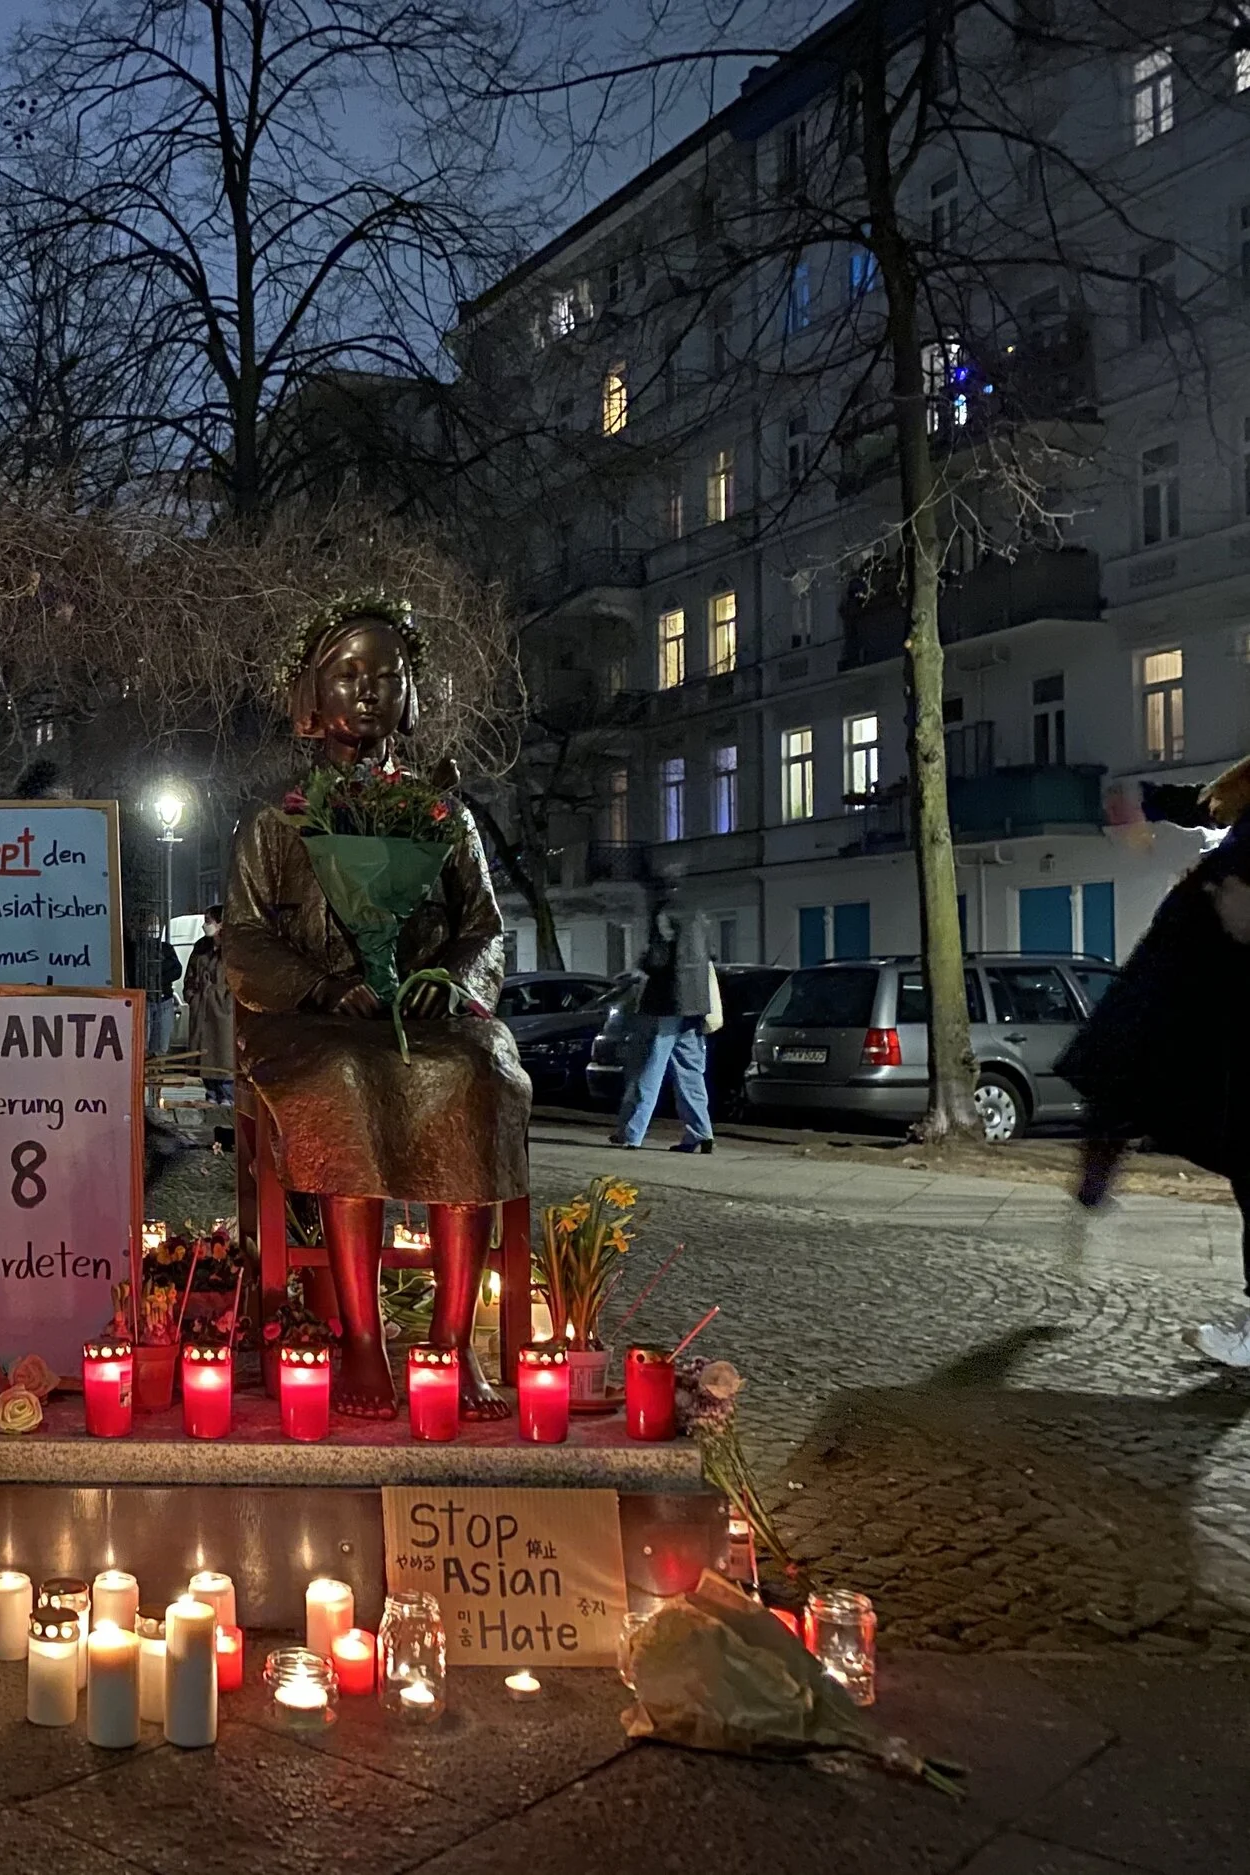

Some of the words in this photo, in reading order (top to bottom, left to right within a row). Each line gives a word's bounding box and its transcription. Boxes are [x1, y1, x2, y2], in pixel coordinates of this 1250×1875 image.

[43, 840, 86, 867] den
[49, 945, 91, 967] und
[74, 1097, 107, 1115] an
[10, 1140, 47, 1209] 8
[410, 1500, 518, 1558] Stop
[525, 1538, 558, 1560] 停止
[395, 1554, 436, 1573] やめる
[443, 1557, 561, 1598] Asian
[478, 1610, 579, 1652] Hate
